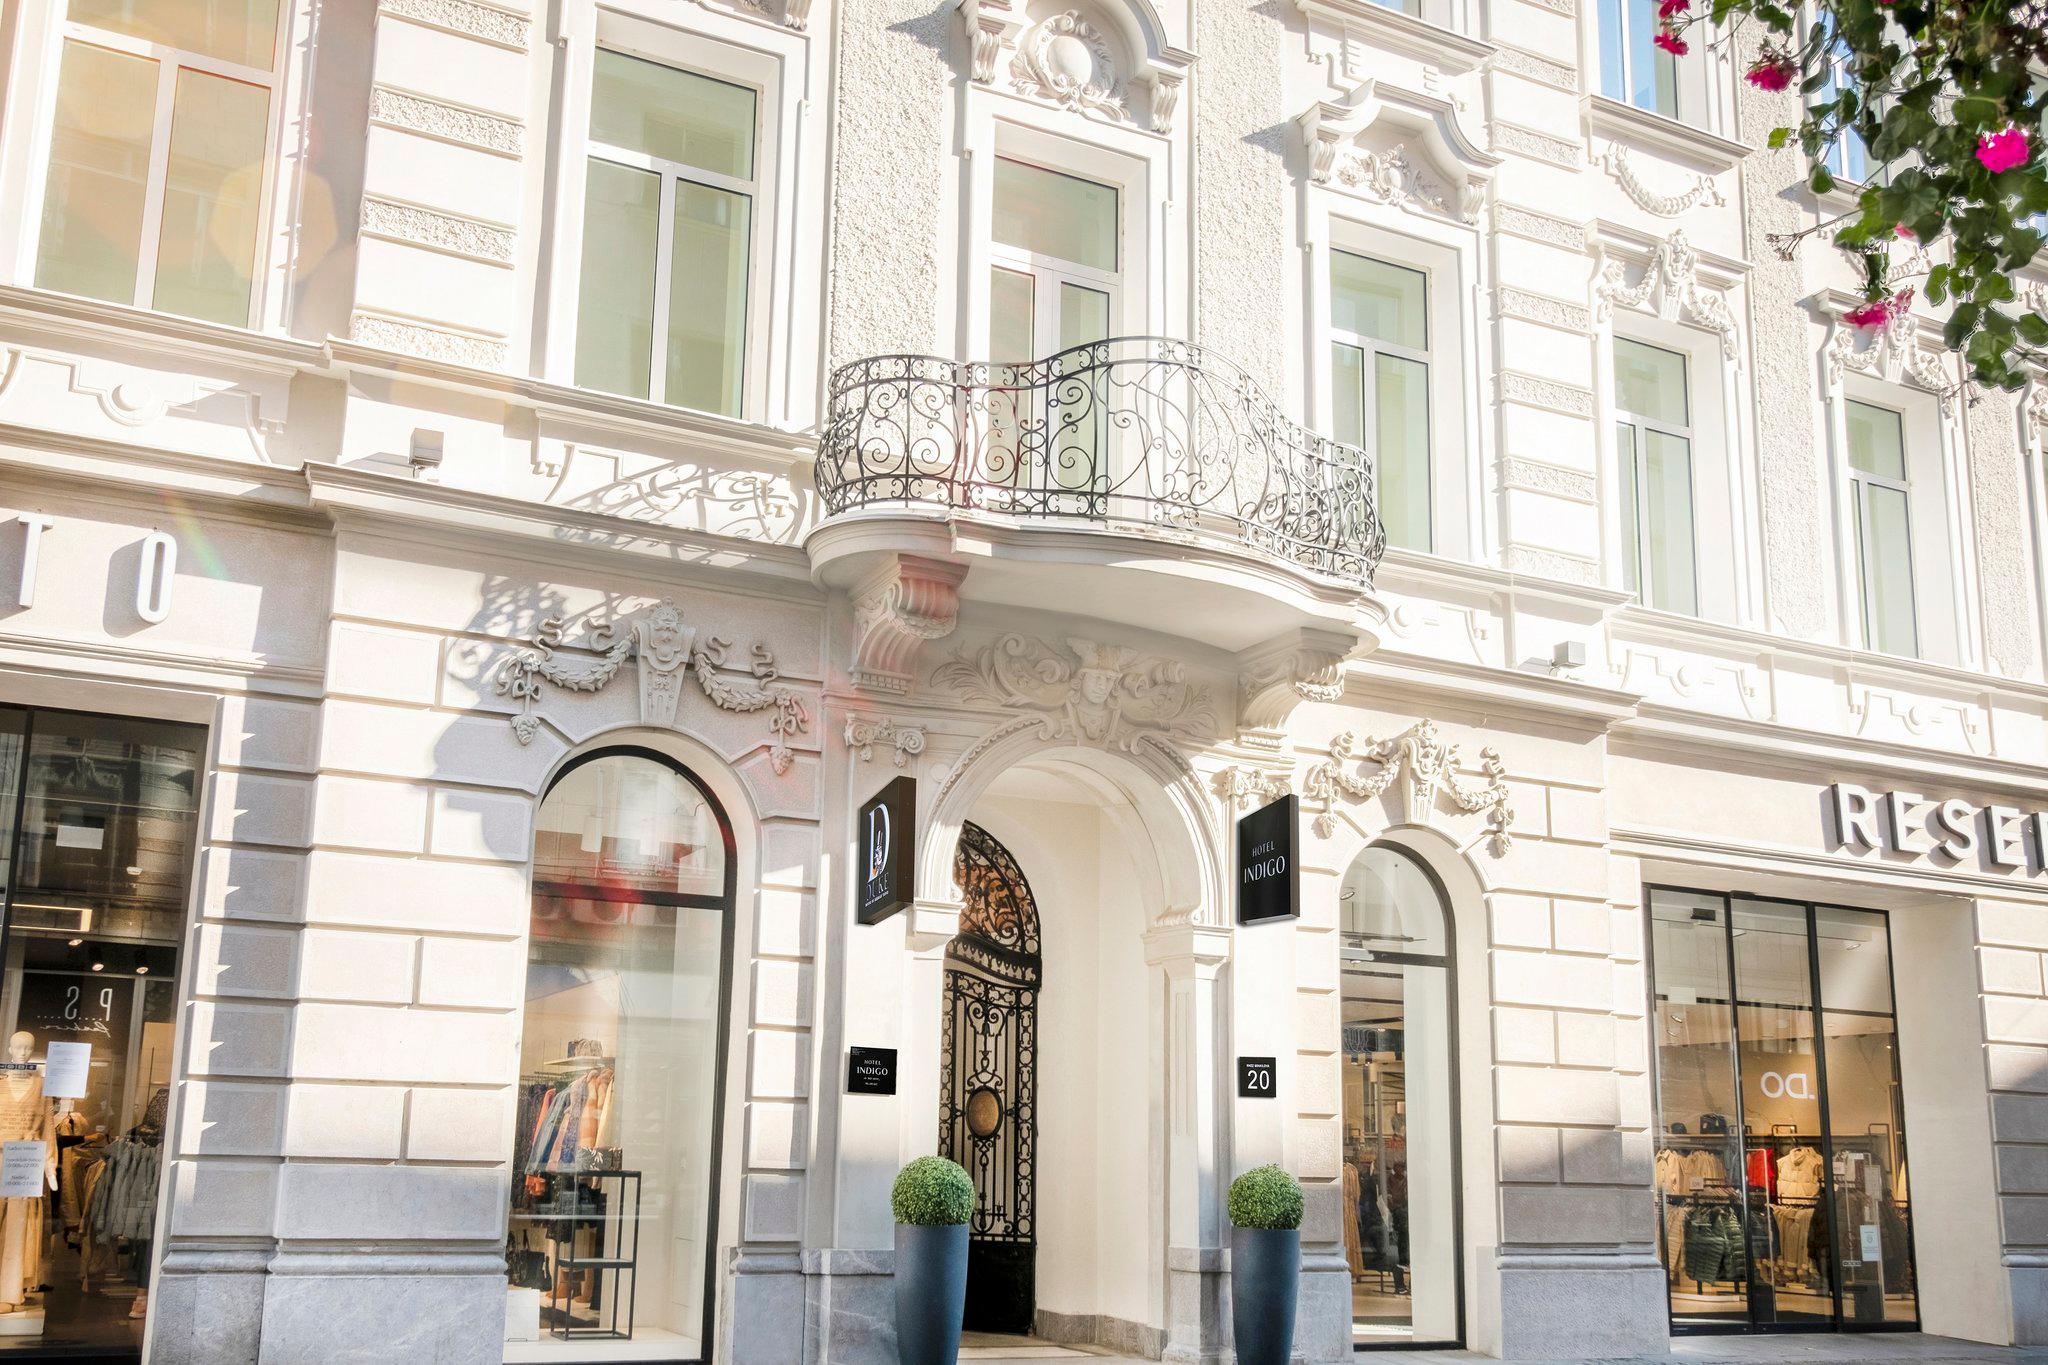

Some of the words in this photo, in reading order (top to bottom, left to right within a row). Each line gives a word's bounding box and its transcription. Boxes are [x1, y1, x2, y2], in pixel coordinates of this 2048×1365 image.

[1252, 841, 1275, 857] HOTEL
[1244, 855, 1285, 883] INDIGO
[856, 1066, 888, 1075] INDIGO
[1247, 1070, 1270, 1089] 20
